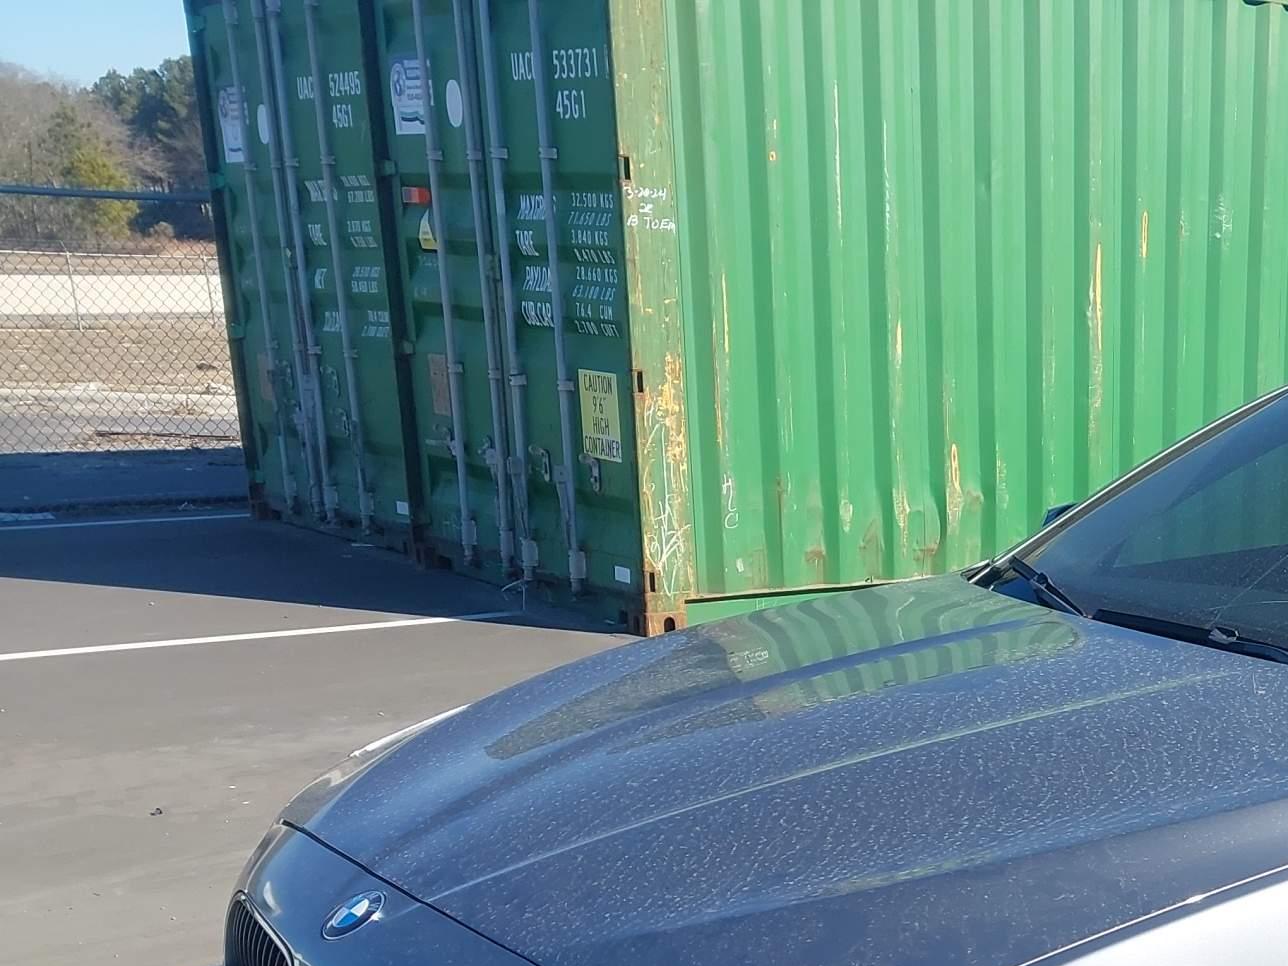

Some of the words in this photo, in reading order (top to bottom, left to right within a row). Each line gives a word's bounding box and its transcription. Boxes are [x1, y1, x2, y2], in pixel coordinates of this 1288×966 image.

[552, 47, 598, 79] 533731
[328, 70, 361, 97] 524495
[556, 89, 586, 119] 45G1
[571, 192, 597, 208] 32.500
[599, 192, 614, 209] KGS
[515, 230, 540, 256] TARE
[594, 230, 608, 246] KGS
[523, 266, 552, 292] PAYLOA
[603, 268, 618, 284] KGS
[583, 373, 613, 395] CAUTION
[592, 415, 610, 437] HIGH
[584, 435, 621, 459] CONTAINER
